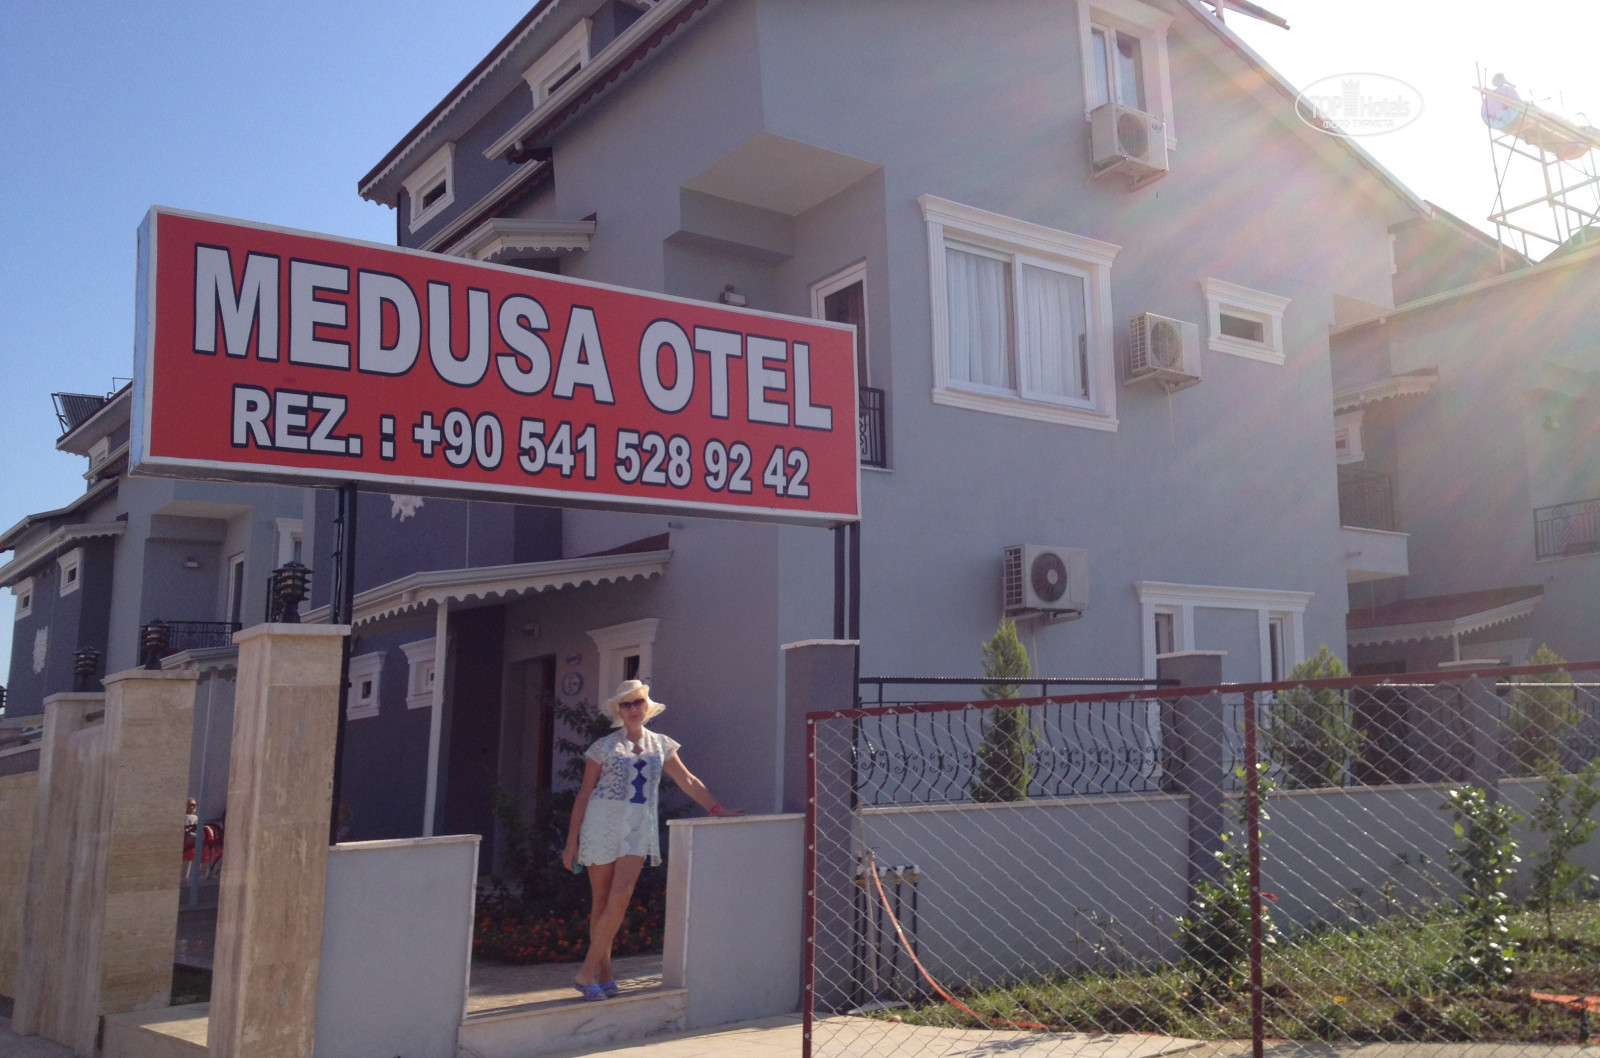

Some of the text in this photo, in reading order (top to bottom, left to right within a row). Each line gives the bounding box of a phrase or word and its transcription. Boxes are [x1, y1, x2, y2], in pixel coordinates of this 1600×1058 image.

[193, 243, 833, 431] MEDUSA OTEL
[231, 383, 363, 457] REZ.
[412, 407, 504, 471] +90
[518, 416, 596, 480] 541
[615, 428, 691, 488] 528
[704, 438, 752, 493] 92
[763, 445, 810, 498] 42
